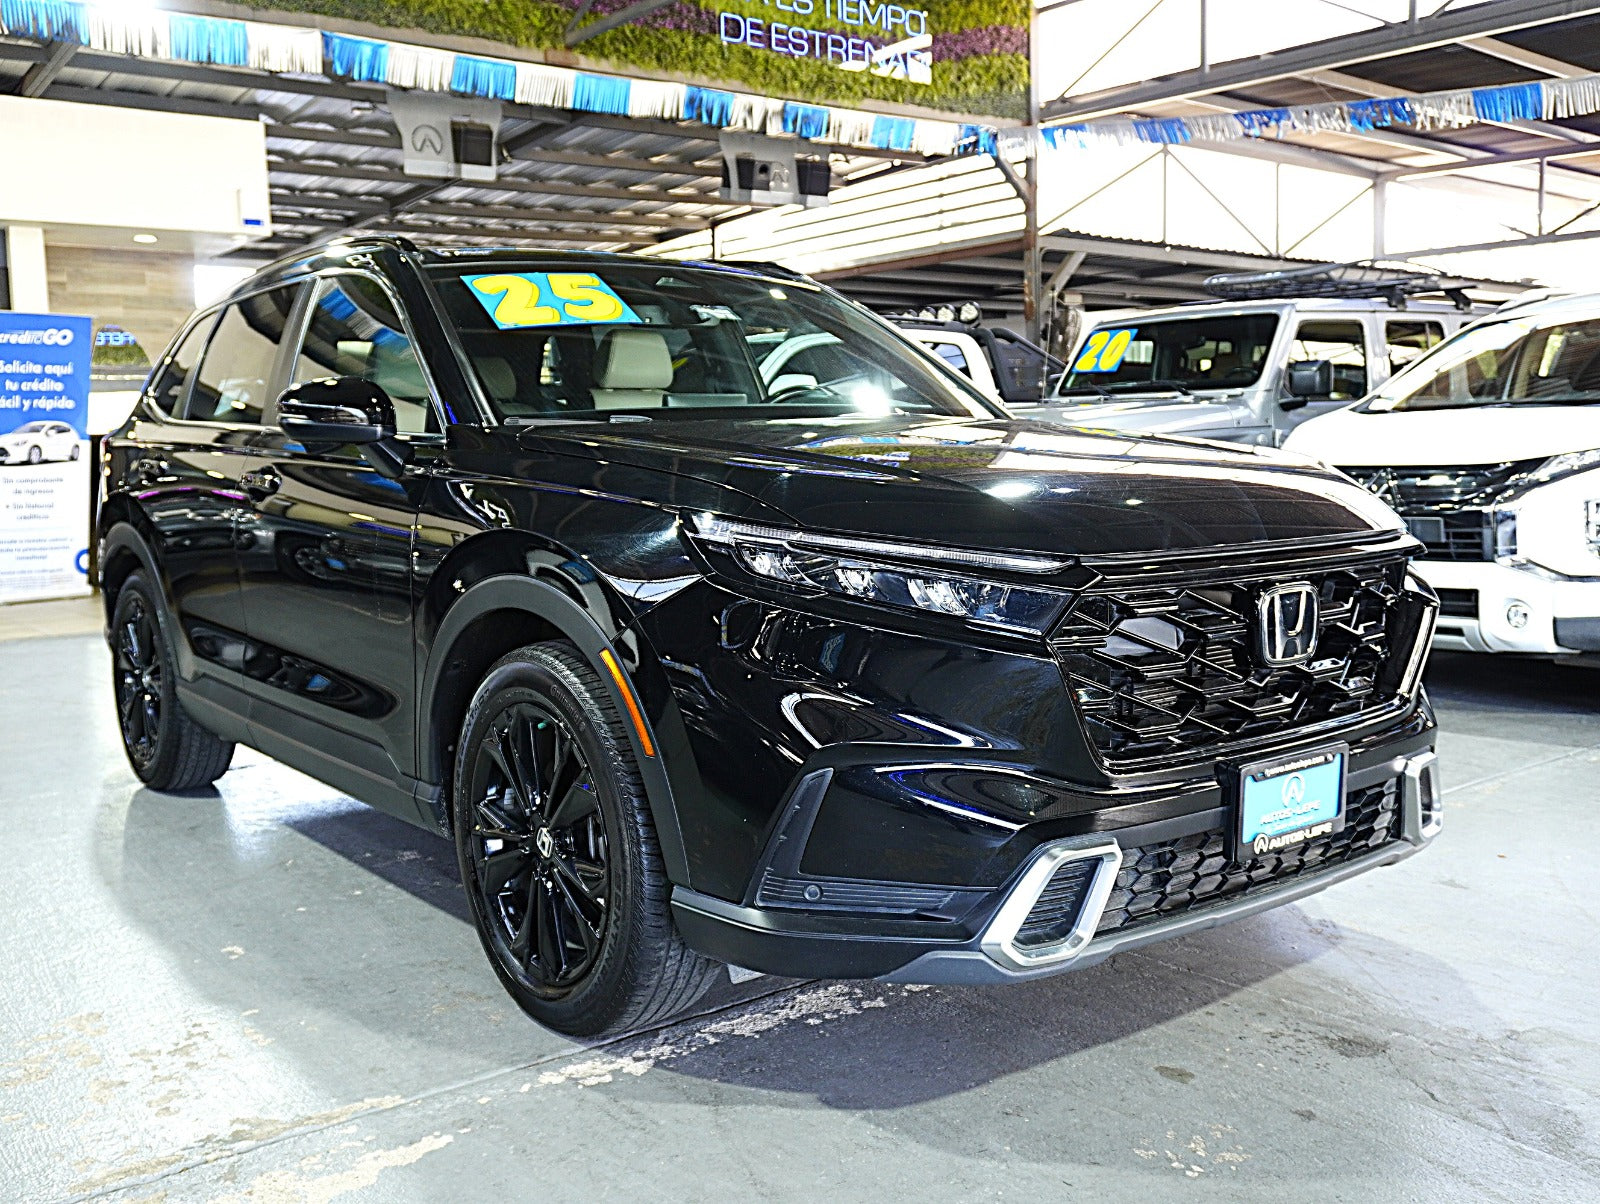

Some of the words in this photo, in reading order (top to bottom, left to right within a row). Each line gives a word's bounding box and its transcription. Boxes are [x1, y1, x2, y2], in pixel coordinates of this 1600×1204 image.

[720, 12, 766, 49] DE
[472, 274, 624, 325] 25
[1075, 329, 1131, 371] 20
[44, 361, 74, 377] aquí
[5, 378, 19, 392] tu
[21, 377, 65, 392] crédito
[22, 398, 32, 412] y
[33, 395, 76, 412] rápido
